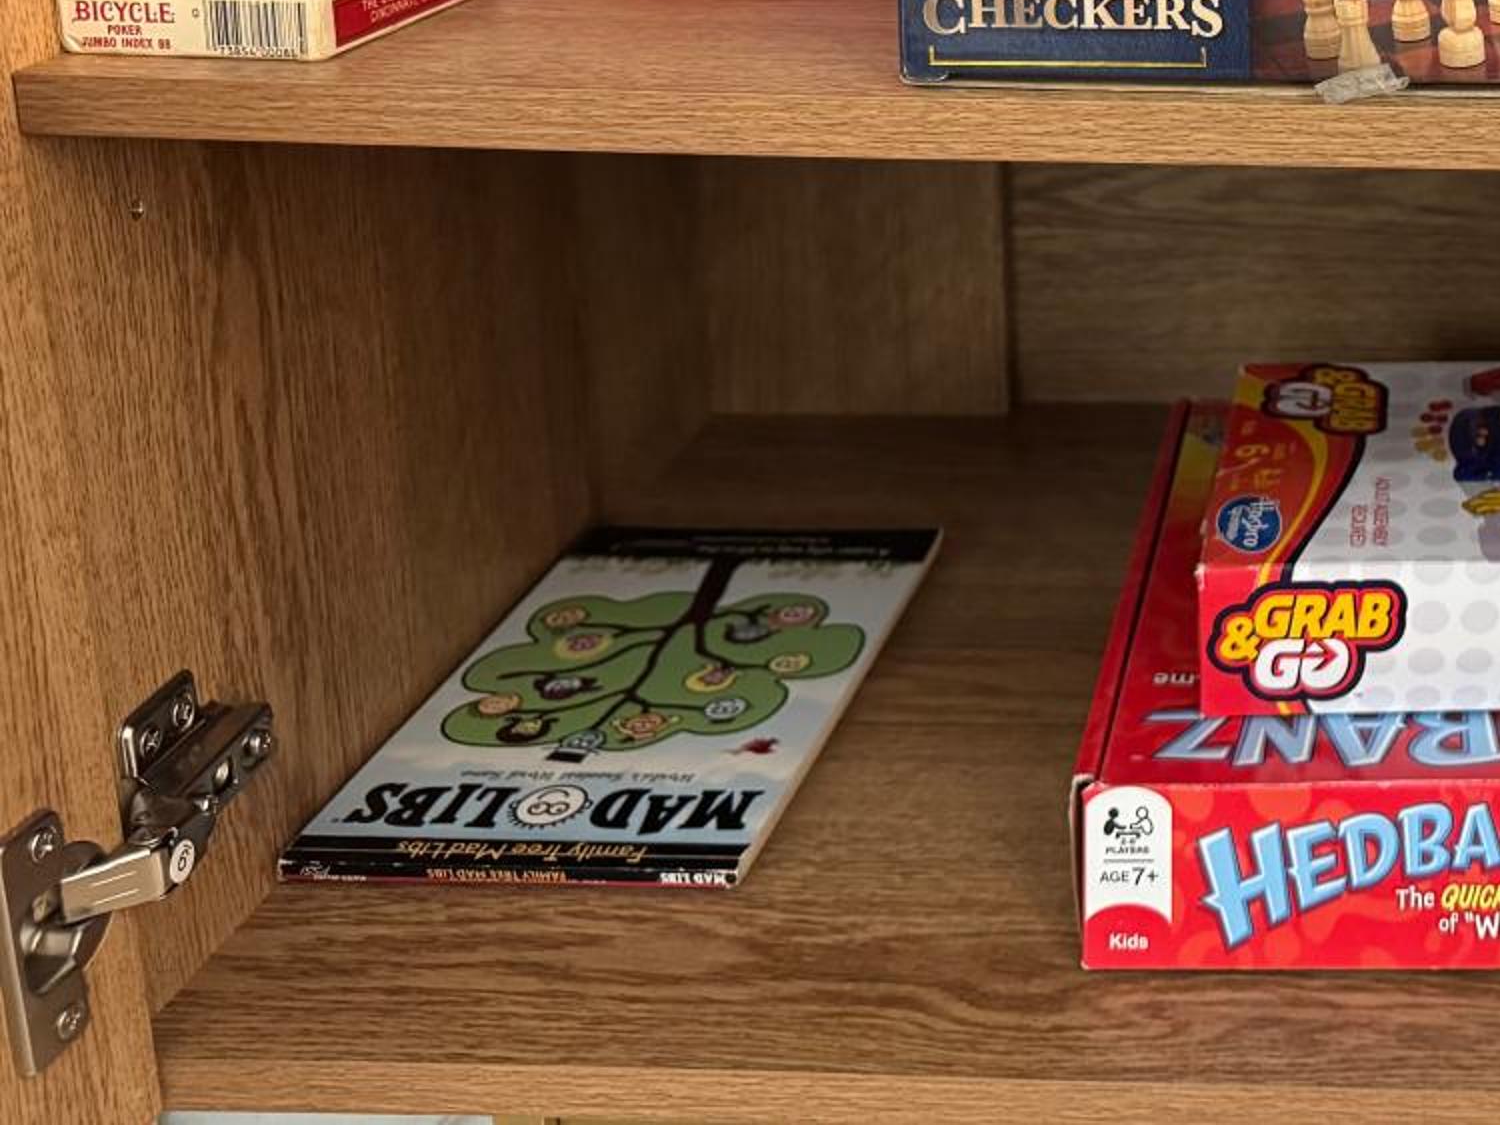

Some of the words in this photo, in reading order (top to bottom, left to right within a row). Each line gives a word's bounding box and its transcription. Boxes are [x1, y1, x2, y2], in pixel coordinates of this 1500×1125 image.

[72, 0, 175, 24] BICYCLE
[107, 24, 143, 36] POKER
[1219, 615, 1260, 662] &
[1254, 590, 1392, 640] GRAB
[1254, 638, 1351, 690] GO
[344, 783, 519, 829] LIBS
[589, 789, 763, 835] MAD
[396, 839, 455, 859] Libs
[453, 841, 505, 860] Mad
[512, 841, 566, 862] Tree
[567, 841, 647, 862] Family
[694, 871, 726, 885] MAD
[1099, 870, 1130, 883] AGE
[1131, 866, 1160, 887] 7+
[1396, 887, 1435, 909] The
[1438, 911, 1459, 934] of
[1109, 932, 1150, 951] Kids
